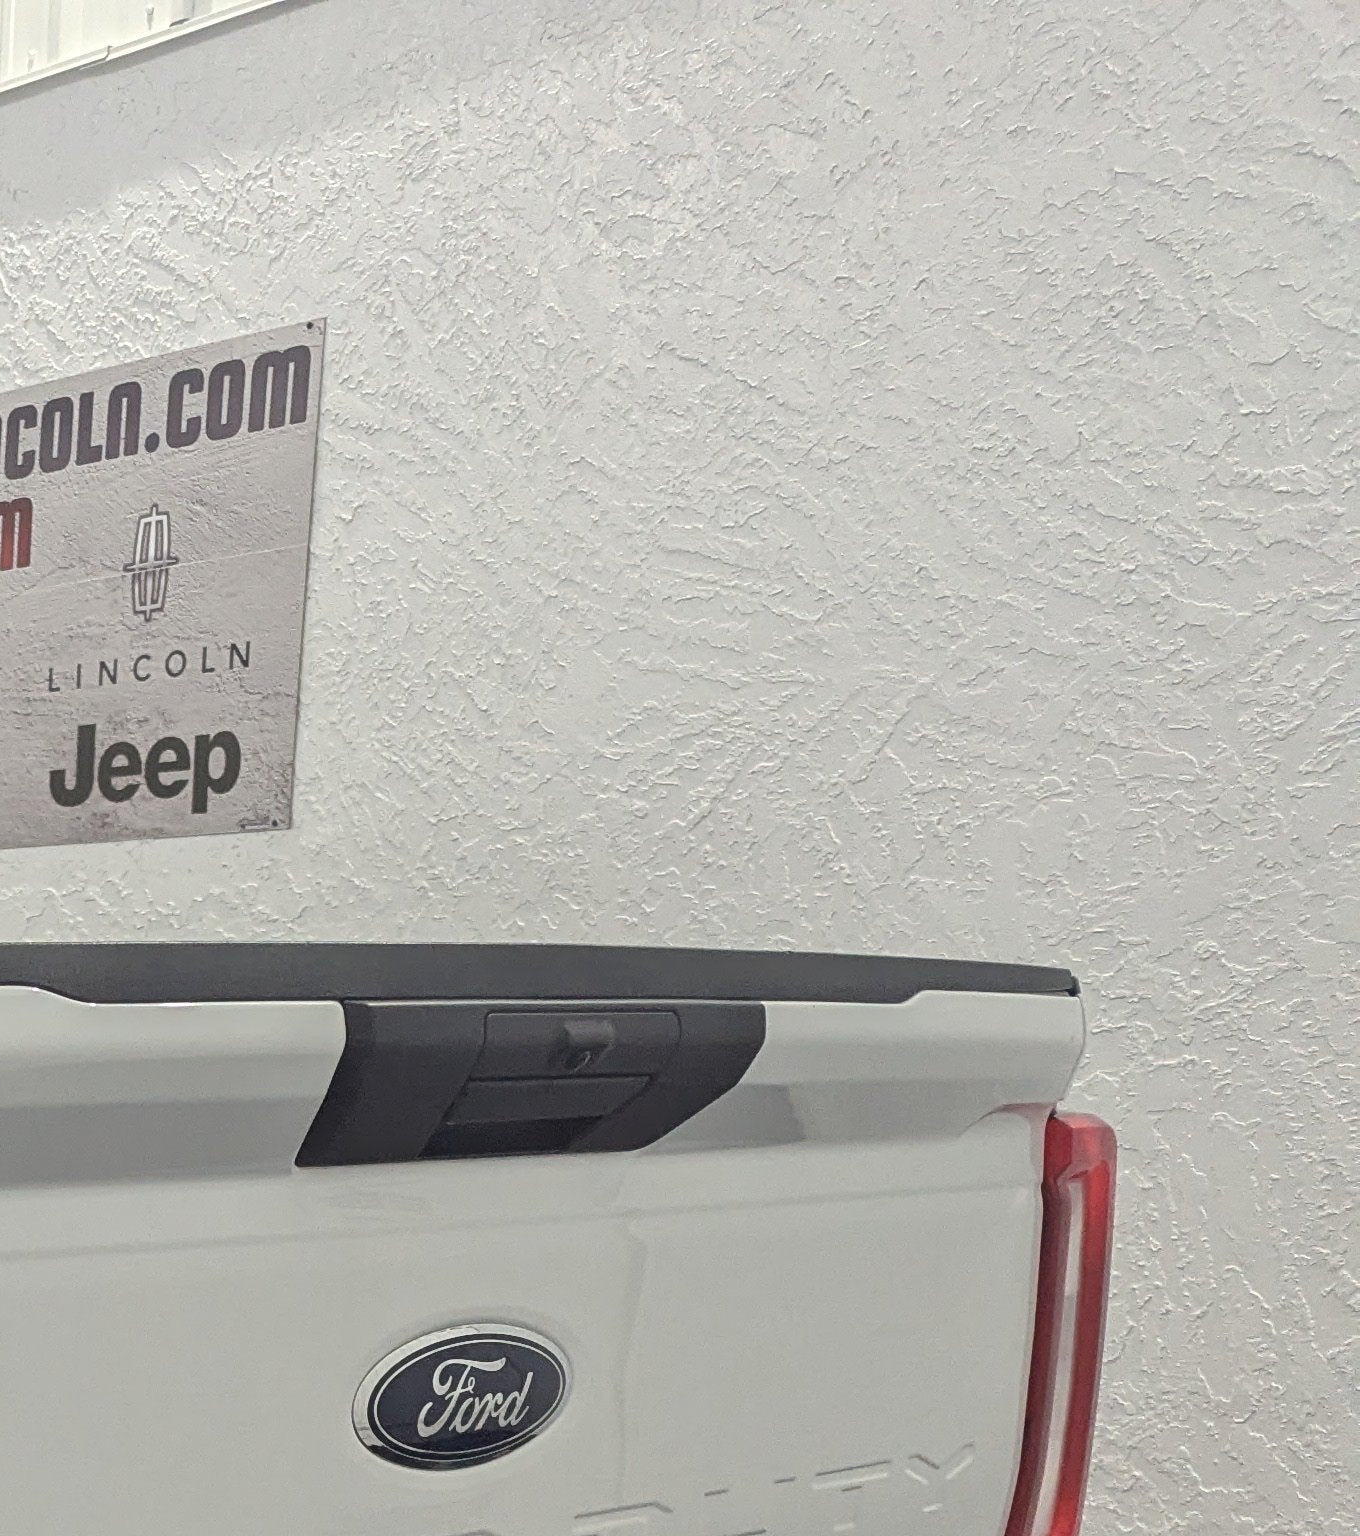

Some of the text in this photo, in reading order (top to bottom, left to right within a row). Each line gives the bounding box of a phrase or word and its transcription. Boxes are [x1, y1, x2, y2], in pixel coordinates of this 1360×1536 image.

[48, 641, 250, 692] LINCOLN
[49, 724, 241, 814] Jeep
[417, 1357, 533, 1437] Ford
